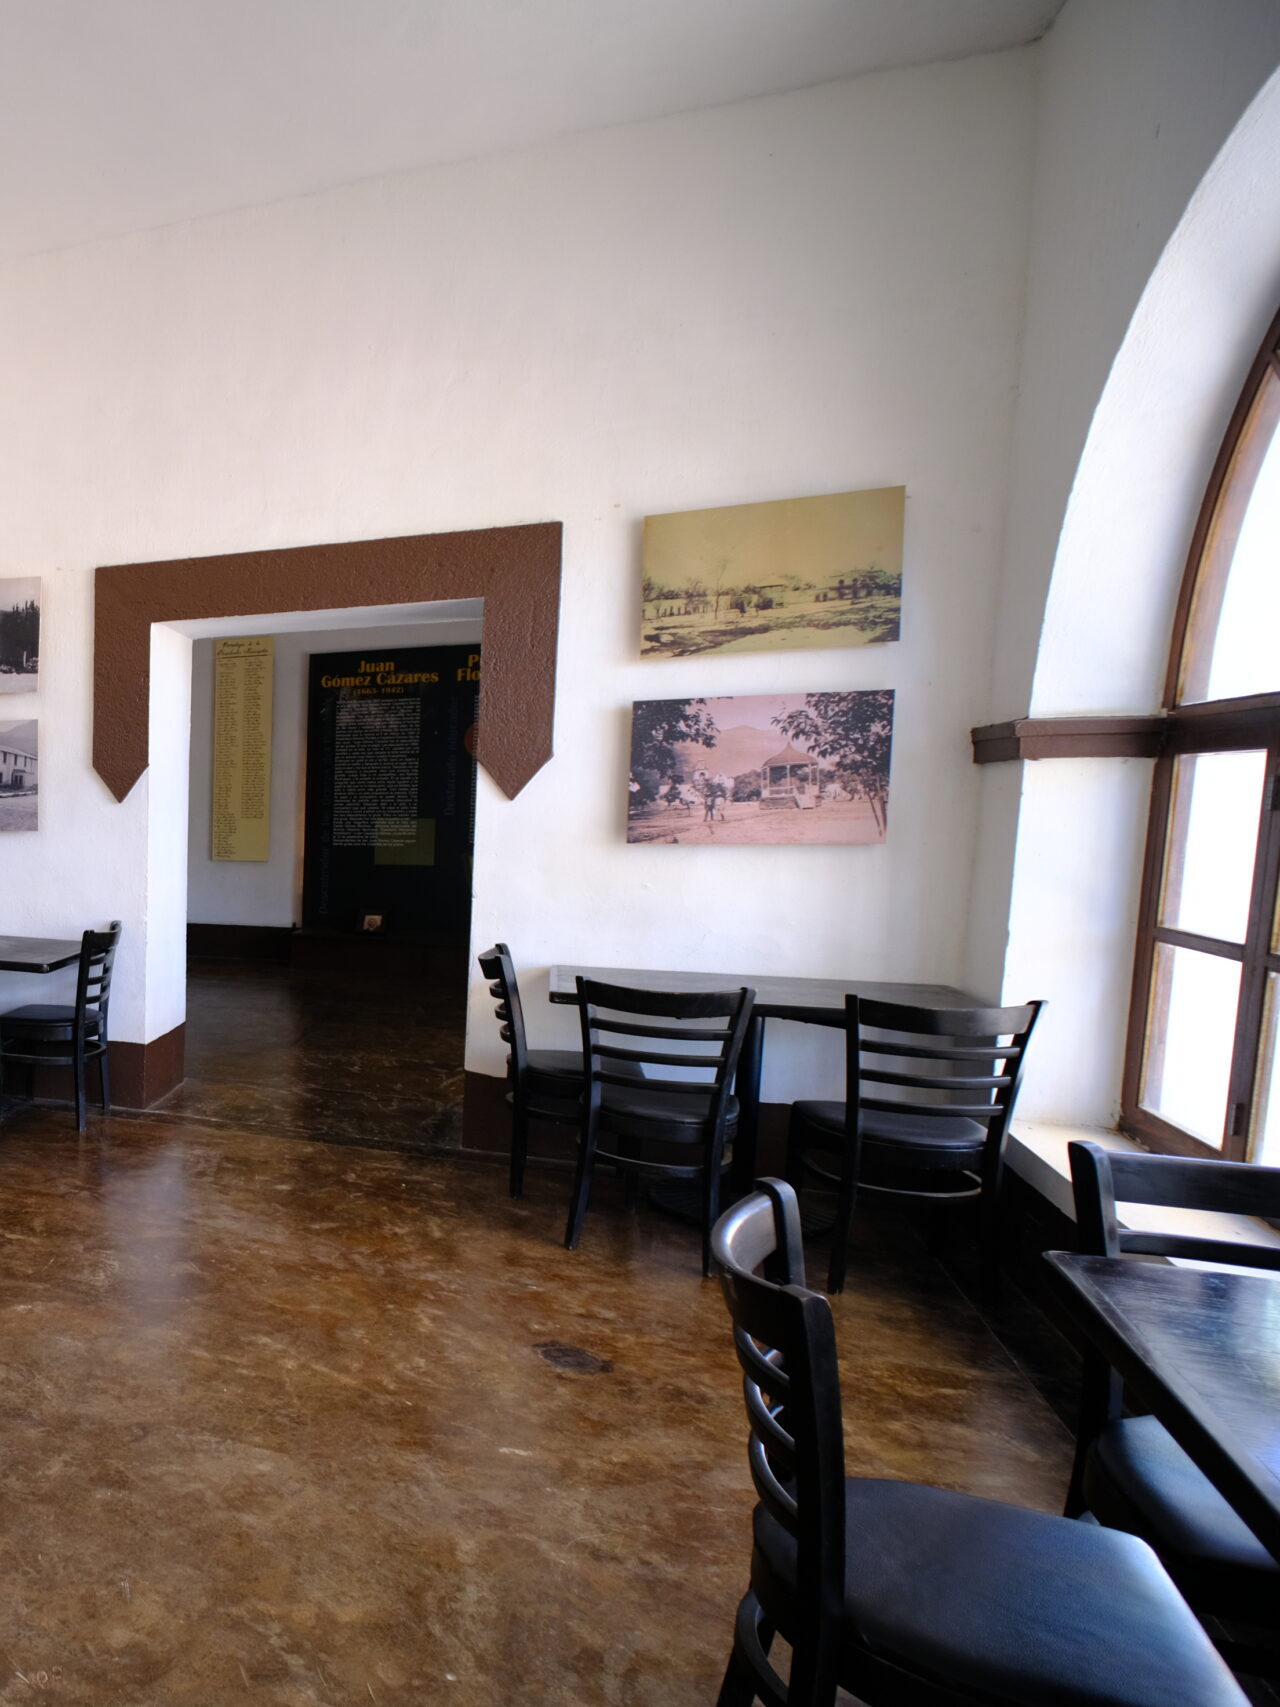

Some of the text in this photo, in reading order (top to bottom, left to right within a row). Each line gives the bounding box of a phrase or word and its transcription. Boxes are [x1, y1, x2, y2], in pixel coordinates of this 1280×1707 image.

[358, 660, 395, 673] Juan
[321, 671, 440, 688] Gómez Cázares
[457, 668, 480, 681] Flo
